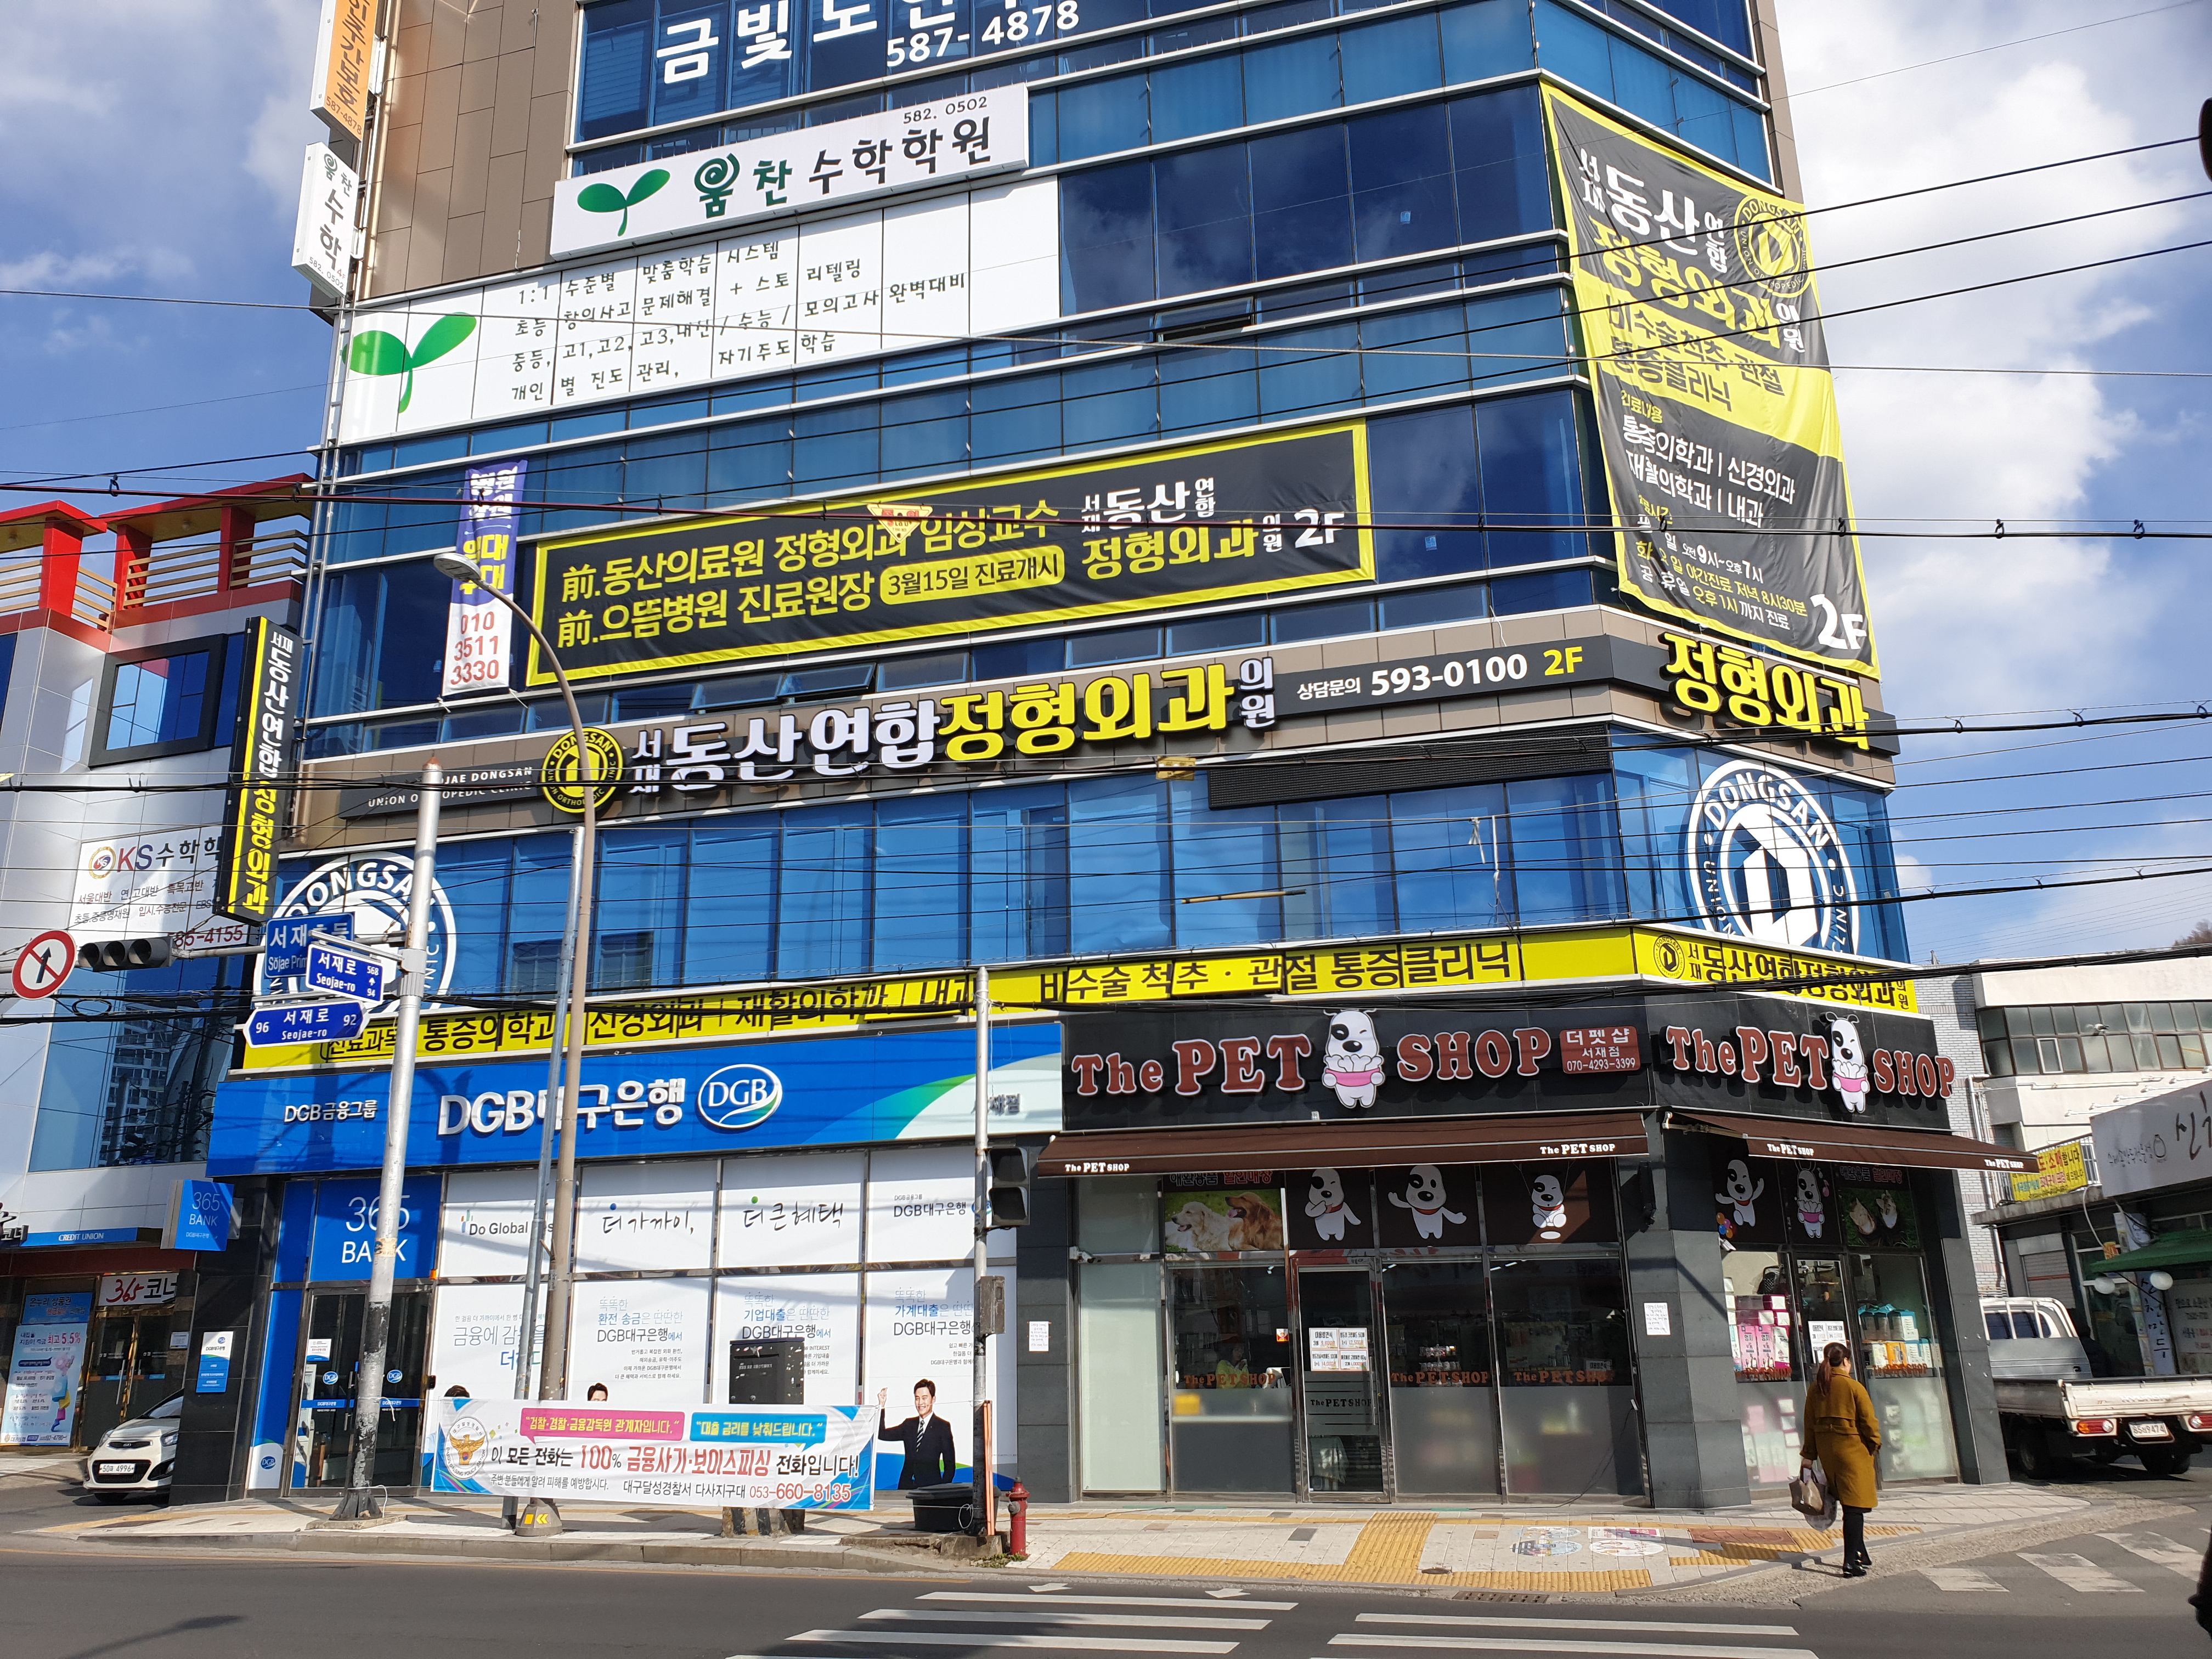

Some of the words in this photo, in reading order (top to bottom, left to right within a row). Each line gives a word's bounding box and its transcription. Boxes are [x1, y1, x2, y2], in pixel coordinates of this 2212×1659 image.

[326, 97, 362, 135] 587-4878
[945, 96, 988, 115] 0502
[809, 116, 991, 195] 수학학원
[1605, 163, 1701, 256] 동산
[319, 188, 344, 271] 수학
[1740, 231, 1753, 266] UNION
[326, 271, 345, 290] 0502
[337, 268, 346, 279] 4F
[520, 285, 548, 304] 1:1
[566, 272, 615, 297] 수준별
[642, 253, 712, 284] 맞춤학습
[727, 241, 778, 263] 시스템
[1589, 215, 1781, 350] 정형외과
[804, 290, 879, 317] 모의고사
[889, 272, 965, 304] 완벽대비
[515, 318, 546, 337] 초등
[564, 301, 631, 330] 창의사고
[641, 286, 710, 316] 문제해결
[591, 368, 623, 390] 진도
[1622, 415, 1713, 476] 통증의학과
[1727, 455, 1795, 505] 신경외과
[1625, 449, 1712, 510] 재활의학과
[1727, 499, 1763, 528] 내과
[773, 523, 911, 572] 정형외과
[920, 499, 1060, 553] 임상교수
[1081, 518, 1260, 580] 정형외과
[1294, 508, 1346, 549] 2F
[737, 571, 874, 624] 진료원장
[888, 566, 968, 596] 3월15일
[974, 553, 1058, 587] 진료개시
[1686, 563, 1732, 591] 야간진료
[1734, 581, 1759, 603] 저녁
[461, 611, 495, 635] 010
[1692, 585, 1718, 606] 오후
[1767, 610, 1791, 630] 진료
[1810, 593, 1867, 650] 2F
[454, 635, 499, 662] 3511
[450, 660, 500, 685] 3330
[1297, 675, 1362, 701] 상담문의
[1370, 653, 1528, 696] 593-0100
[1543, 646, 1584, 676] 2F
[1663, 632, 1870, 751] 정형외과
[471, 766, 532, 782] DONGSAN
[368, 794, 405, 808] UNION
[1704, 771, 1830, 851] DONGSAN
[78, 890, 112, 905] 서울대반
[167, 879, 205, 895] 특목고반
[1656, 936, 1680, 951] DONGSAN
[318, 952, 357, 975] 서재로
[366, 965, 379, 976] 568
[1040, 967, 1131, 1003] 비수술
[1142, 960, 1208, 995] 척추
[1248, 955, 1317, 993] 관절
[1330, 940, 1512, 988] 통증클리닉
[316, 973, 356, 992] Seojae-ro
[366, 988, 376, 998] 94
[283, 1007, 330, 1025] 서재로
[343, 1014, 357, 1026] 92
[255, 1022, 269, 1034] 96
[281, 1028, 328, 1041] Seojae-ro
[1071, 1052, 1164, 1096] The
[1172, 1033, 1312, 1096] PET
[1396, 1027, 1551, 1081] SHOP
[1581, 1046, 1621, 1059] 서재점
[1666, 1024, 1736, 1075] The
[1735, 1025, 1829, 1091] PET
[1872, 1047, 1956, 1099] SHOP
[1567, 1058, 1636, 1072] 070-4293-3399
[708, 1078, 768, 1107] DGB
[284, 1099, 377, 1123] DGB금융그룹
[1539, 1146, 1560, 1155] The
[1560, 1143, 1589, 1155] PET
[1589, 1143, 1616, 1153] SHOP
[1766, 1143, 1781, 1153] The
[1780, 1143, 1798, 1156] PET
[1797, 1146, 1814, 1156] SHOP
[1065, 1164, 1082, 1173] The
[1082, 1161, 1107, 1173] PET
[1107, 1163, 1130, 1172] SHOP
[1996, 1158, 2011, 1169] PET
[2010, 1161, 2024, 1169] SHOP
[192, 1192, 221, 1211] 365
[894, 1201, 967, 1217] DGB대구은행
[189, 1213, 218, 1227] BANK
[469, 1223, 486, 1235] Do
[489, 1222, 528, 1235] Global
[58, 1233, 81, 1242] CREDIT
[81, 1232, 104, 1240] UNION
[30, 1297, 49, 1307] 온누리
[52, 1296, 71, 1306] 상품권
[106, 1278, 144, 1303] 365
[744, 1291, 774, 1307] 똑똑한
[894, 1286, 926, 1303] 똑똑한
[599, 1295, 629, 1311] 똑똑한
[895, 1304, 950, 1317] 가계대출은
[743, 1307, 796, 1322] 기업대출은
[61, 1332, 81, 1344] 5.5%
[453, 1325, 498, 1346] 금융에
[1184, 1374, 1205, 1385] The
[1206, 1373, 1239, 1386] PET
[1240, 1373, 1277, 1386] SHOP
[1391, 1373, 1414, 1383] The
[1415, 1371, 1449, 1384] PET
[1451, 1371, 1489, 1384] SHOP
[1325, 1398, 1347, 1407] PET
[1348, 1398, 1372, 1407] SHOP
[723, 1421, 748, 1436] 금리를
[115, 1464, 131, 1472] 4996
[491, 1446, 503, 1465] 이
[507, 1446, 530, 1465] 모든
[534, 1447, 574, 1467] 전화는
[580, 1444, 622, 1470] 100%
[776, 1454, 860, 1478] 전화입니다!
[531, 1475, 545, 1488] 알려
[546, 1476, 569, 1489] 피해를
[570, 1477, 609, 1491] 예방합시다.
[623, 1480, 692, 1498] 대구달성경찰서
[695, 1483, 746, 1498] 다사지구대
[749, 1482, 851, 1502] 053-660-8135
